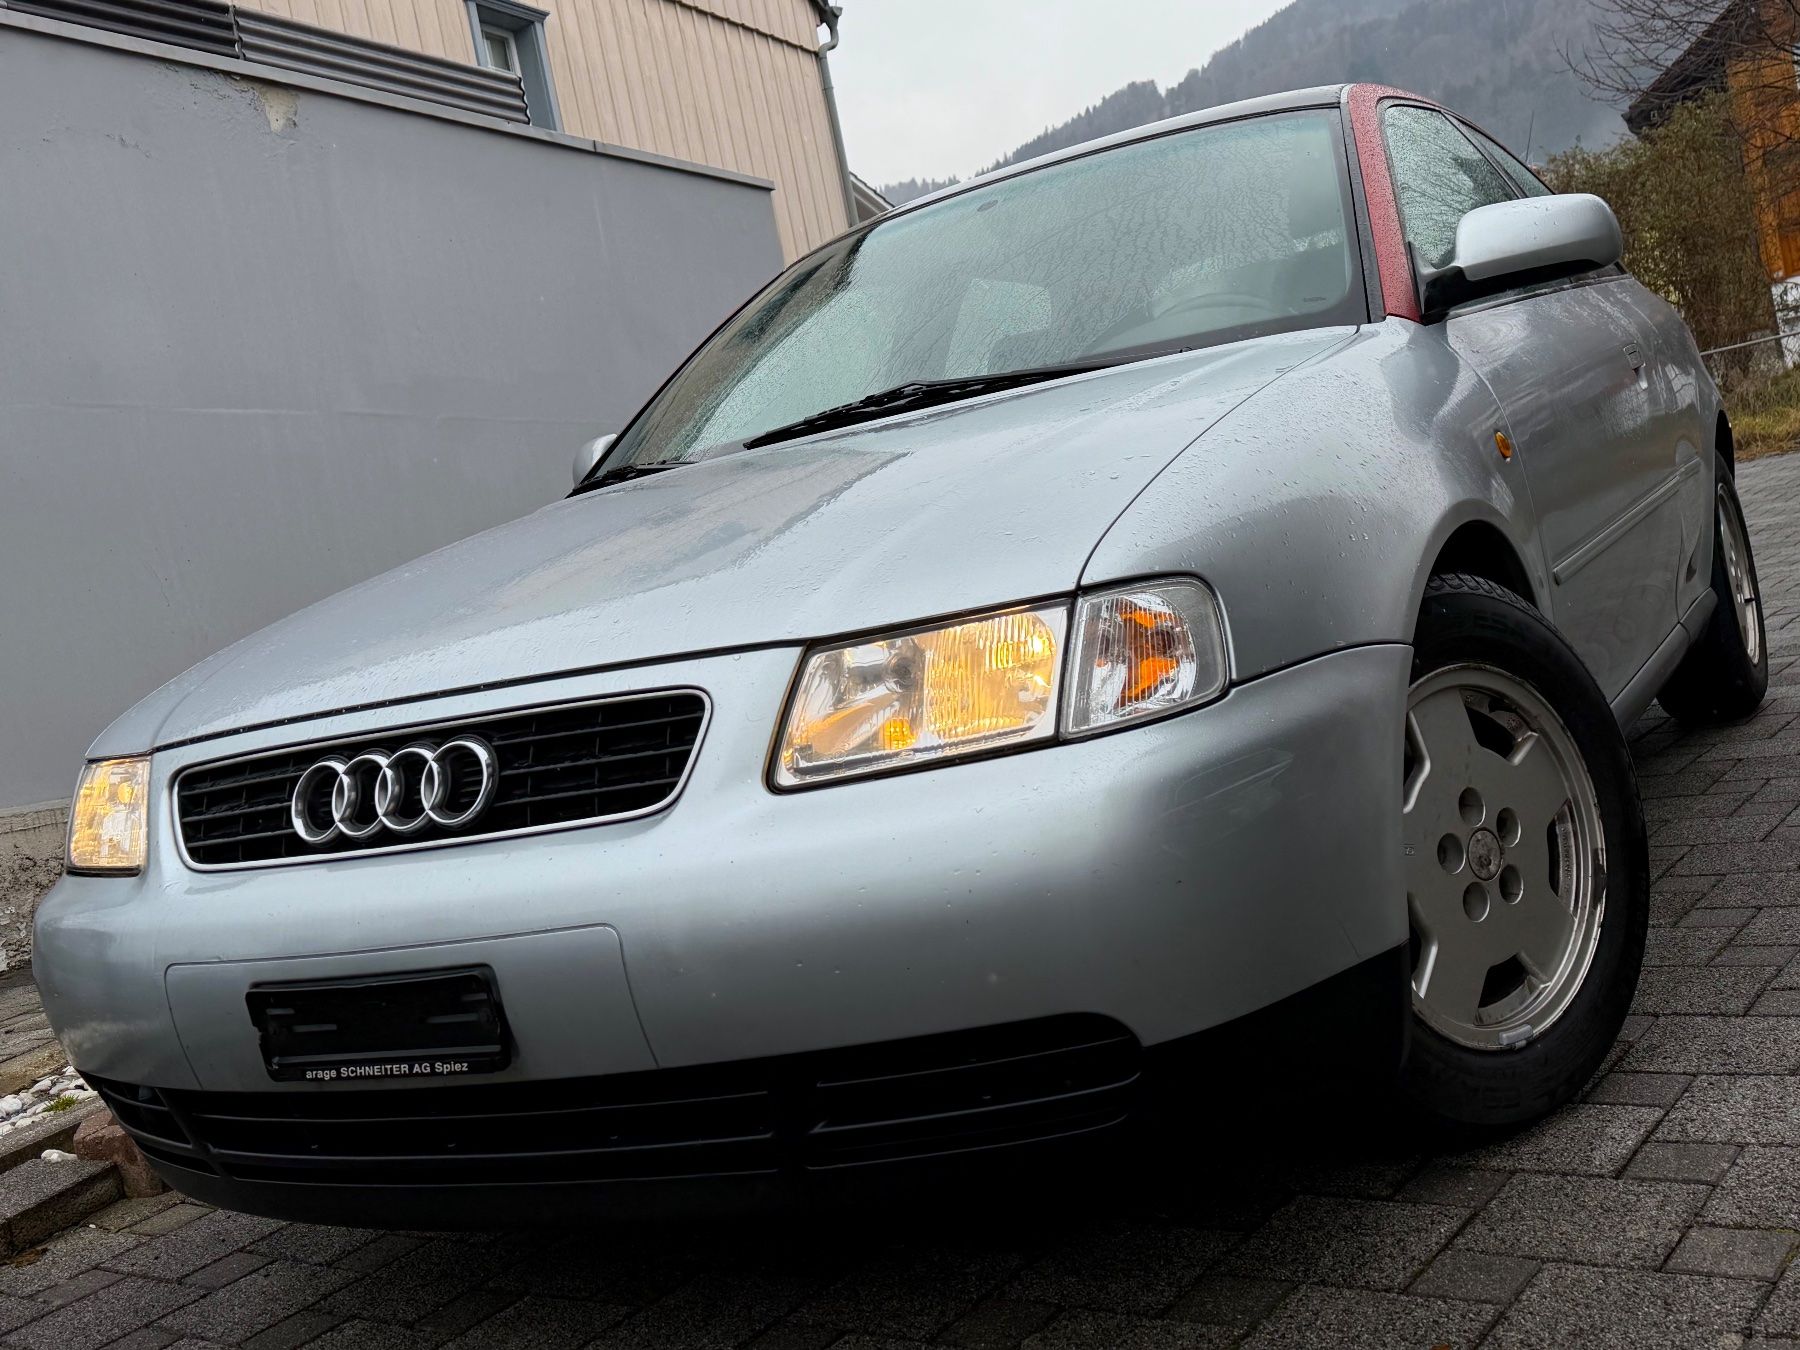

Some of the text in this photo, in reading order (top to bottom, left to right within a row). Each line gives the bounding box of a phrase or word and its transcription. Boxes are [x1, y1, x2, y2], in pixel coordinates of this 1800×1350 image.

[340, 1064, 409, 1077] SCHNEITER
[412, 1062, 431, 1074] AG
[434, 1061, 468, 1074] Spiez
